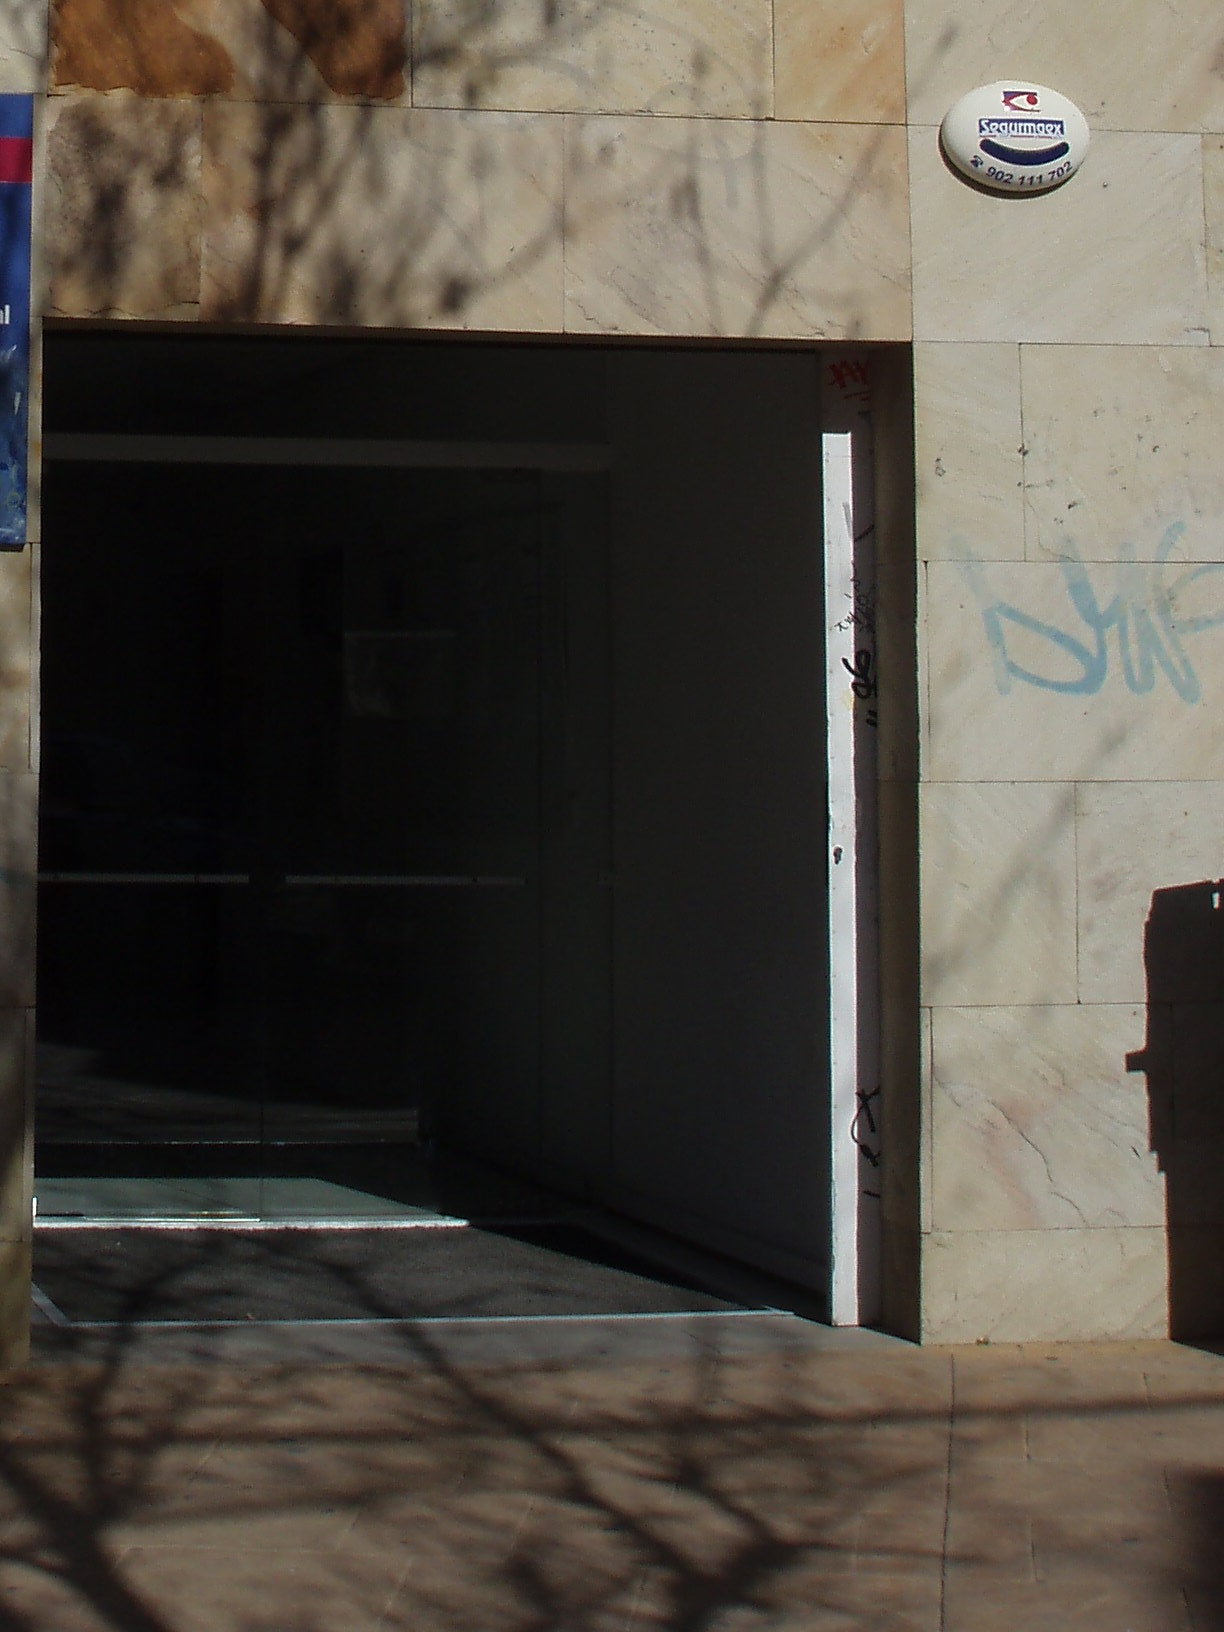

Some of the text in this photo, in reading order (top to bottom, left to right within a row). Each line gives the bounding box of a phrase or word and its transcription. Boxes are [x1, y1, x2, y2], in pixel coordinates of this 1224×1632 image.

[986, 161, 1073, 186] 902 111 702
